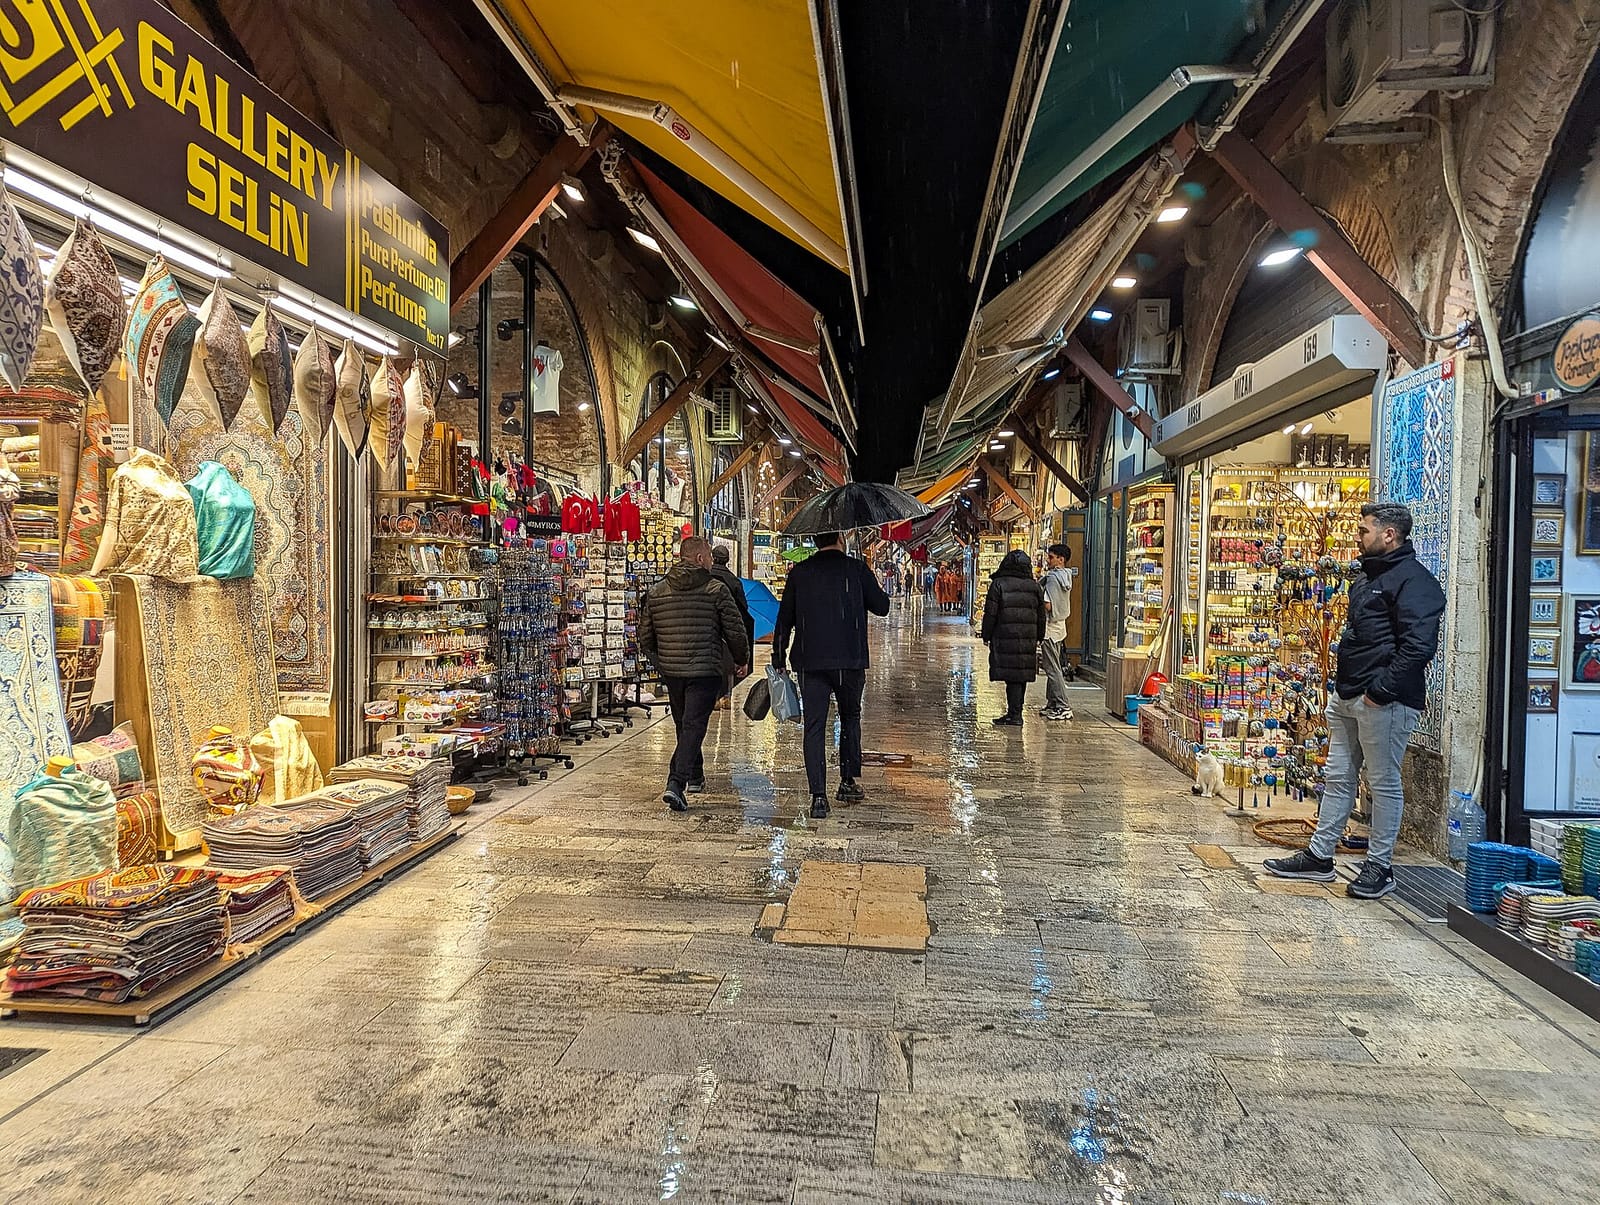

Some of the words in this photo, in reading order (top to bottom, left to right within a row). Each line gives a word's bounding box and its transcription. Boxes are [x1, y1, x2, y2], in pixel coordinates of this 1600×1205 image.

[138, 21, 340, 211] GALLERY
[361, 180, 438, 266] Pashmina
[361, 228, 389, 269] Pure
[390, 248, 434, 297] Perfume
[434, 276, 446, 305] Oil
[361, 264, 427, 330] Perfume
[1303, 333, 1318, 365] 159
